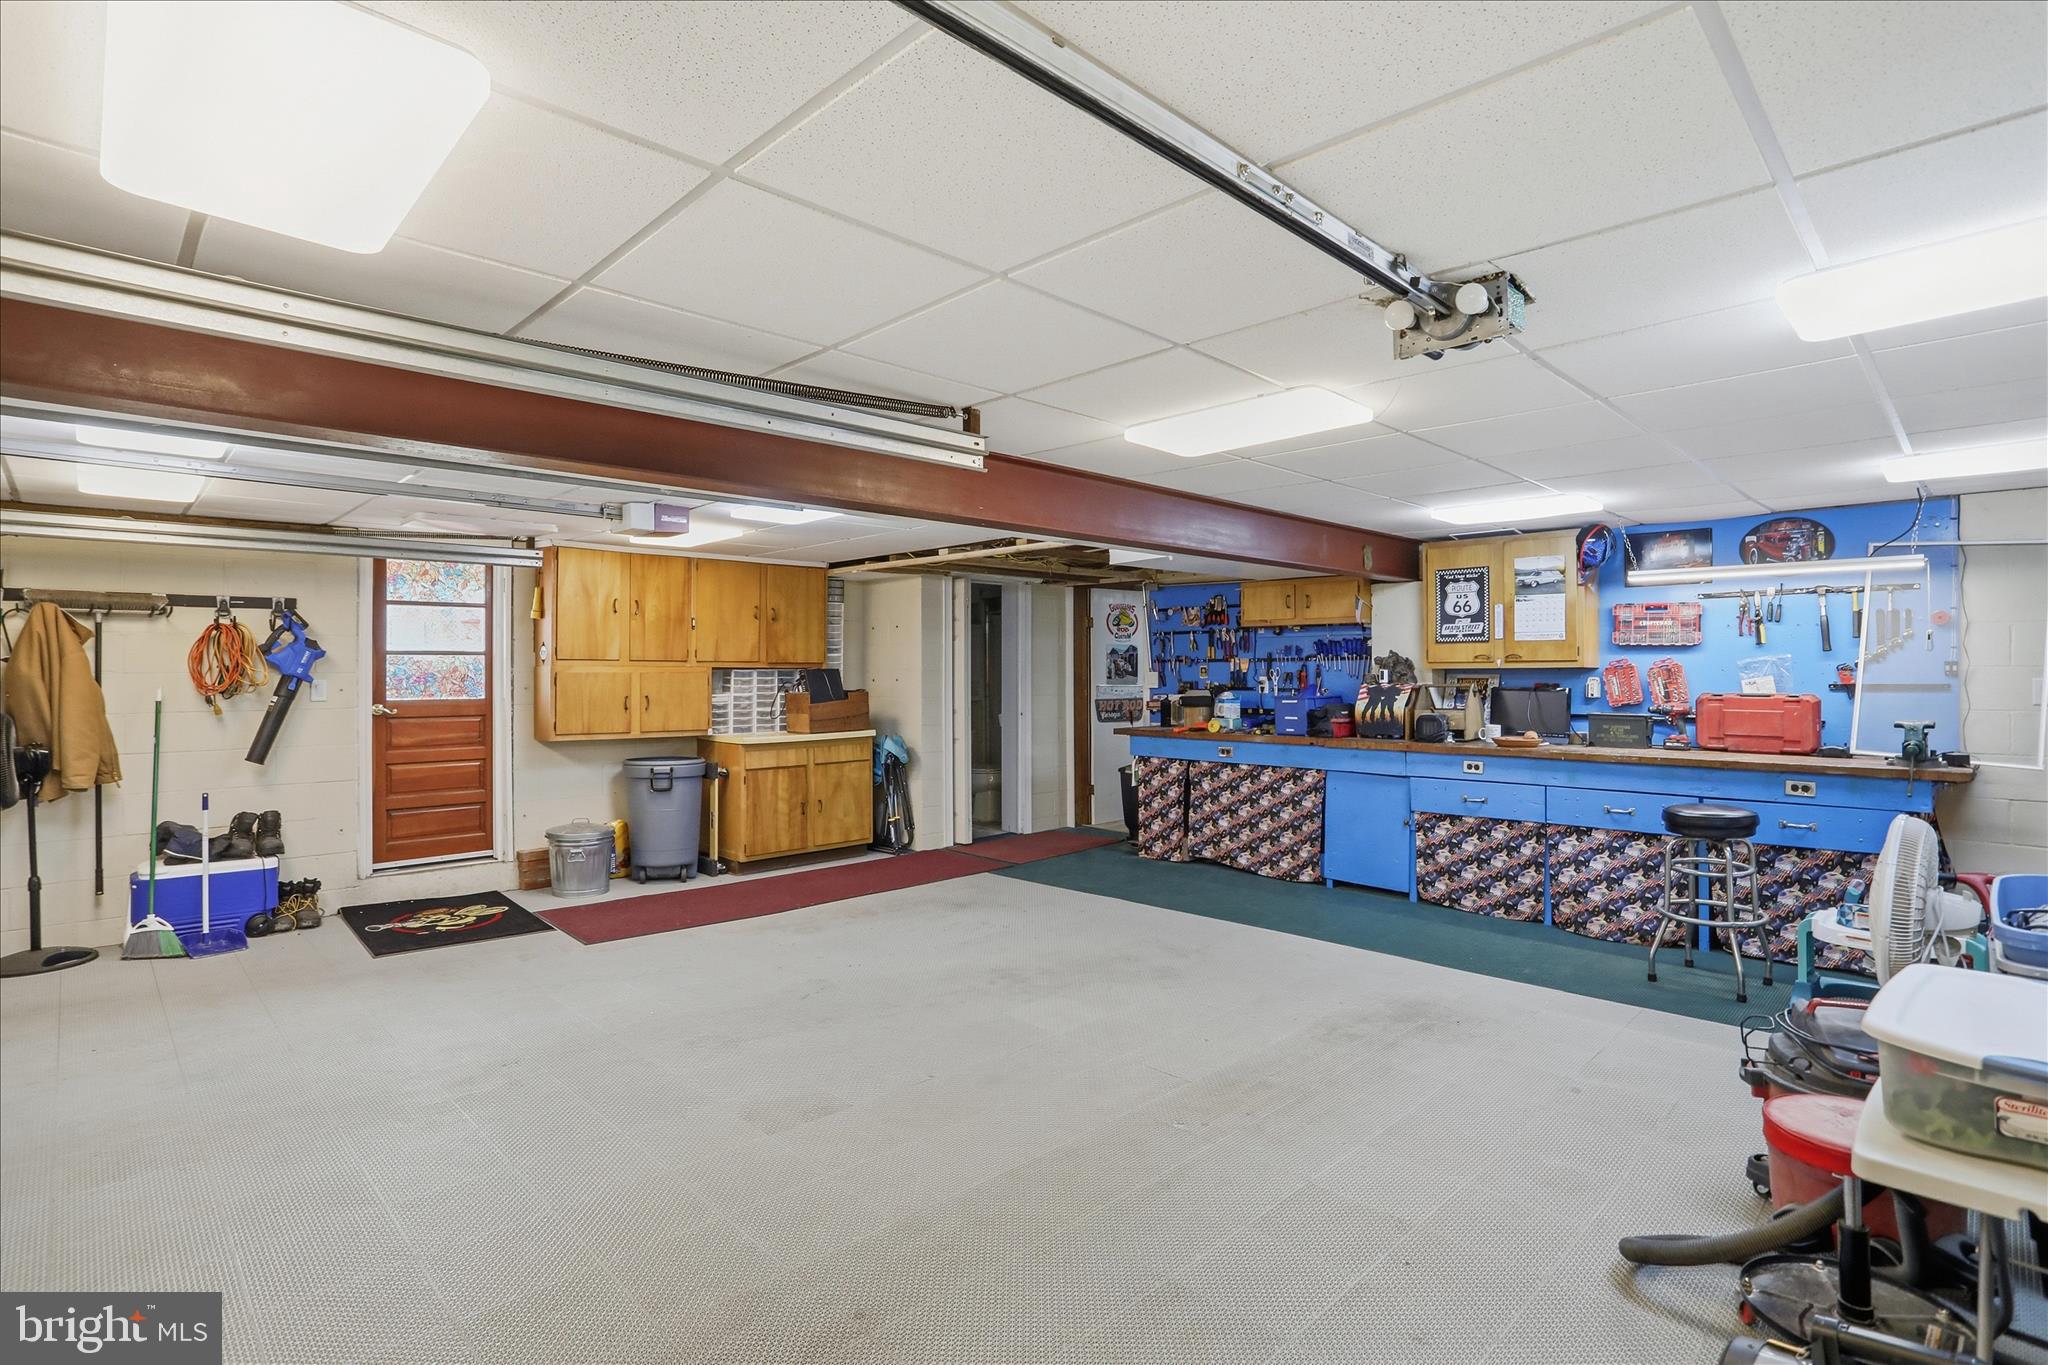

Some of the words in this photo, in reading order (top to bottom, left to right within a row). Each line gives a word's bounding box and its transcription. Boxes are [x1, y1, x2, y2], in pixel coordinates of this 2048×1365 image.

[1453, 600, 1472, 613] 66
[1099, 700, 1121, 711] HOT
[1122, 699, 1143, 711] ROD
